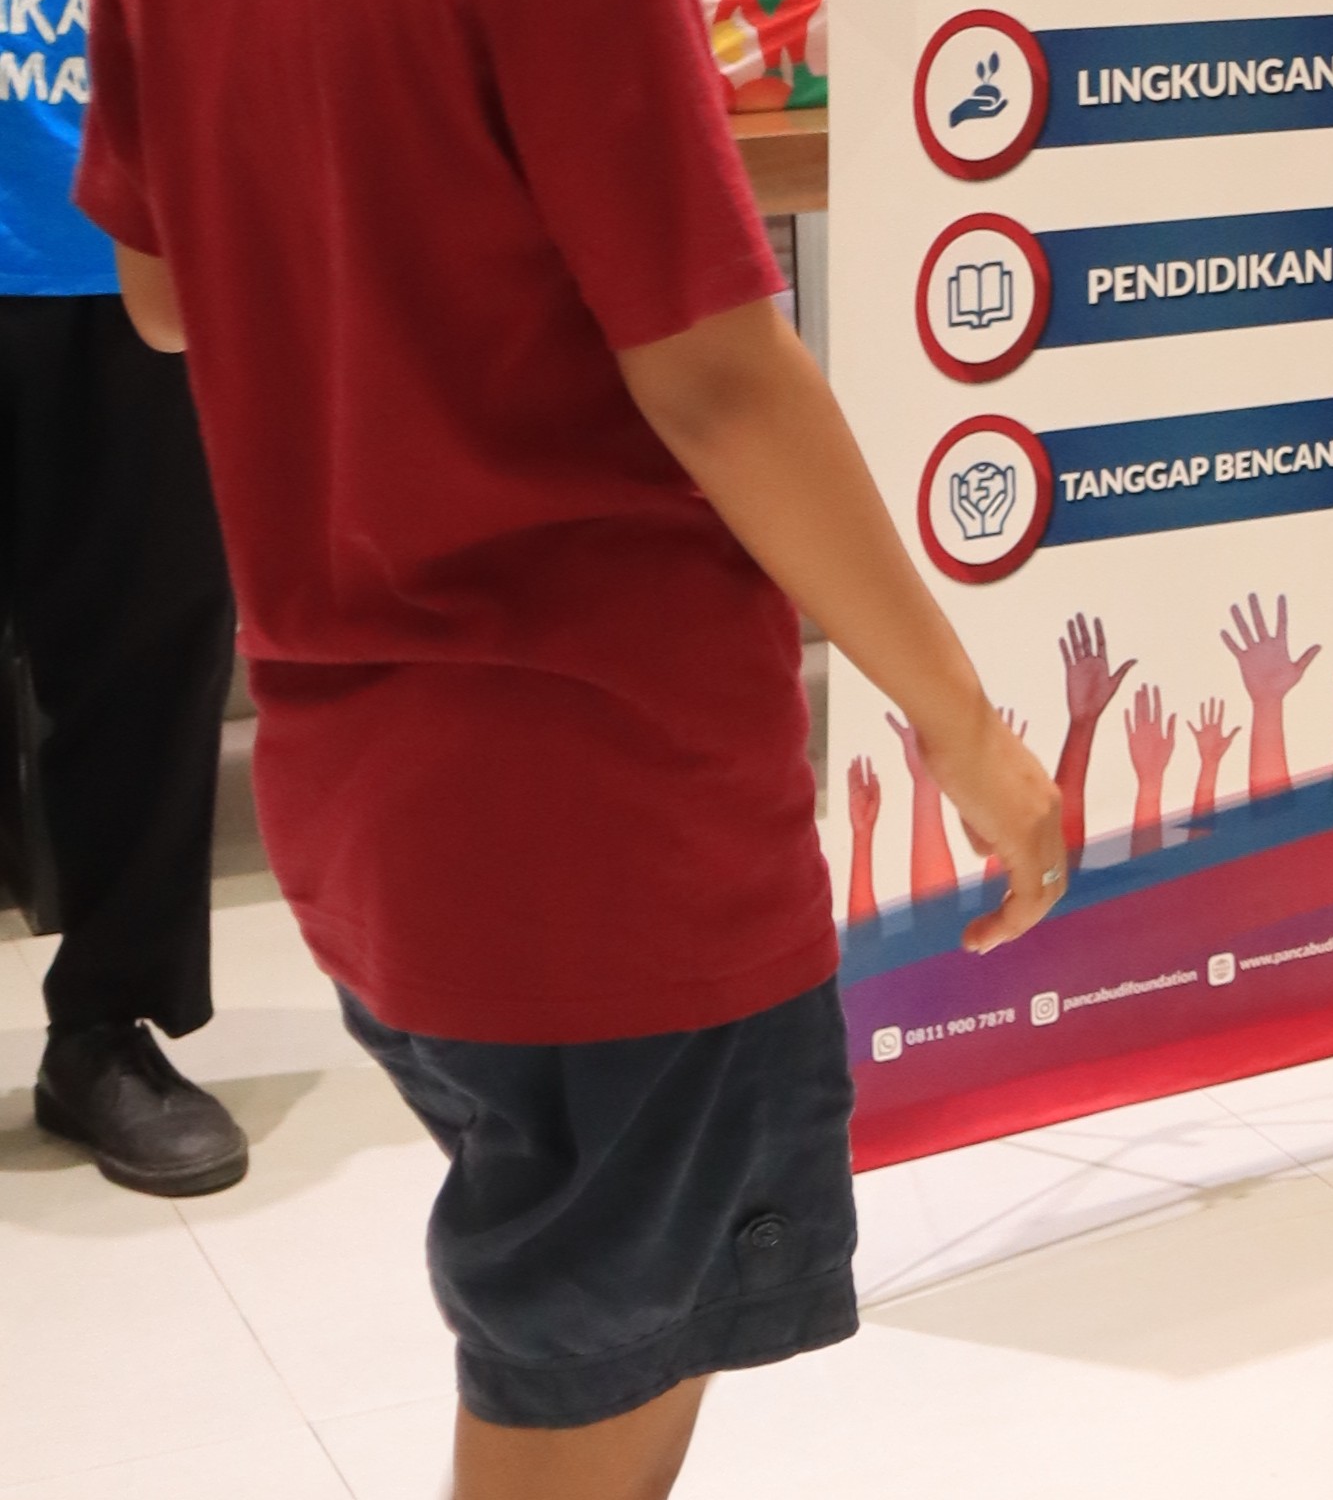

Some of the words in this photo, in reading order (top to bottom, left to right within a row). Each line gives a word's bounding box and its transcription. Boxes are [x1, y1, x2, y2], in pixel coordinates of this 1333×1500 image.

[1087, 246, 1333, 305] PENDIDIKAN
[1059, 456, 1211, 502] TANGGAP
[1062, 968, 1198, 1013] pancabudifoundation
[904, 1023, 945, 1047] 0811
[946, 1016, 977, 1037] 900
